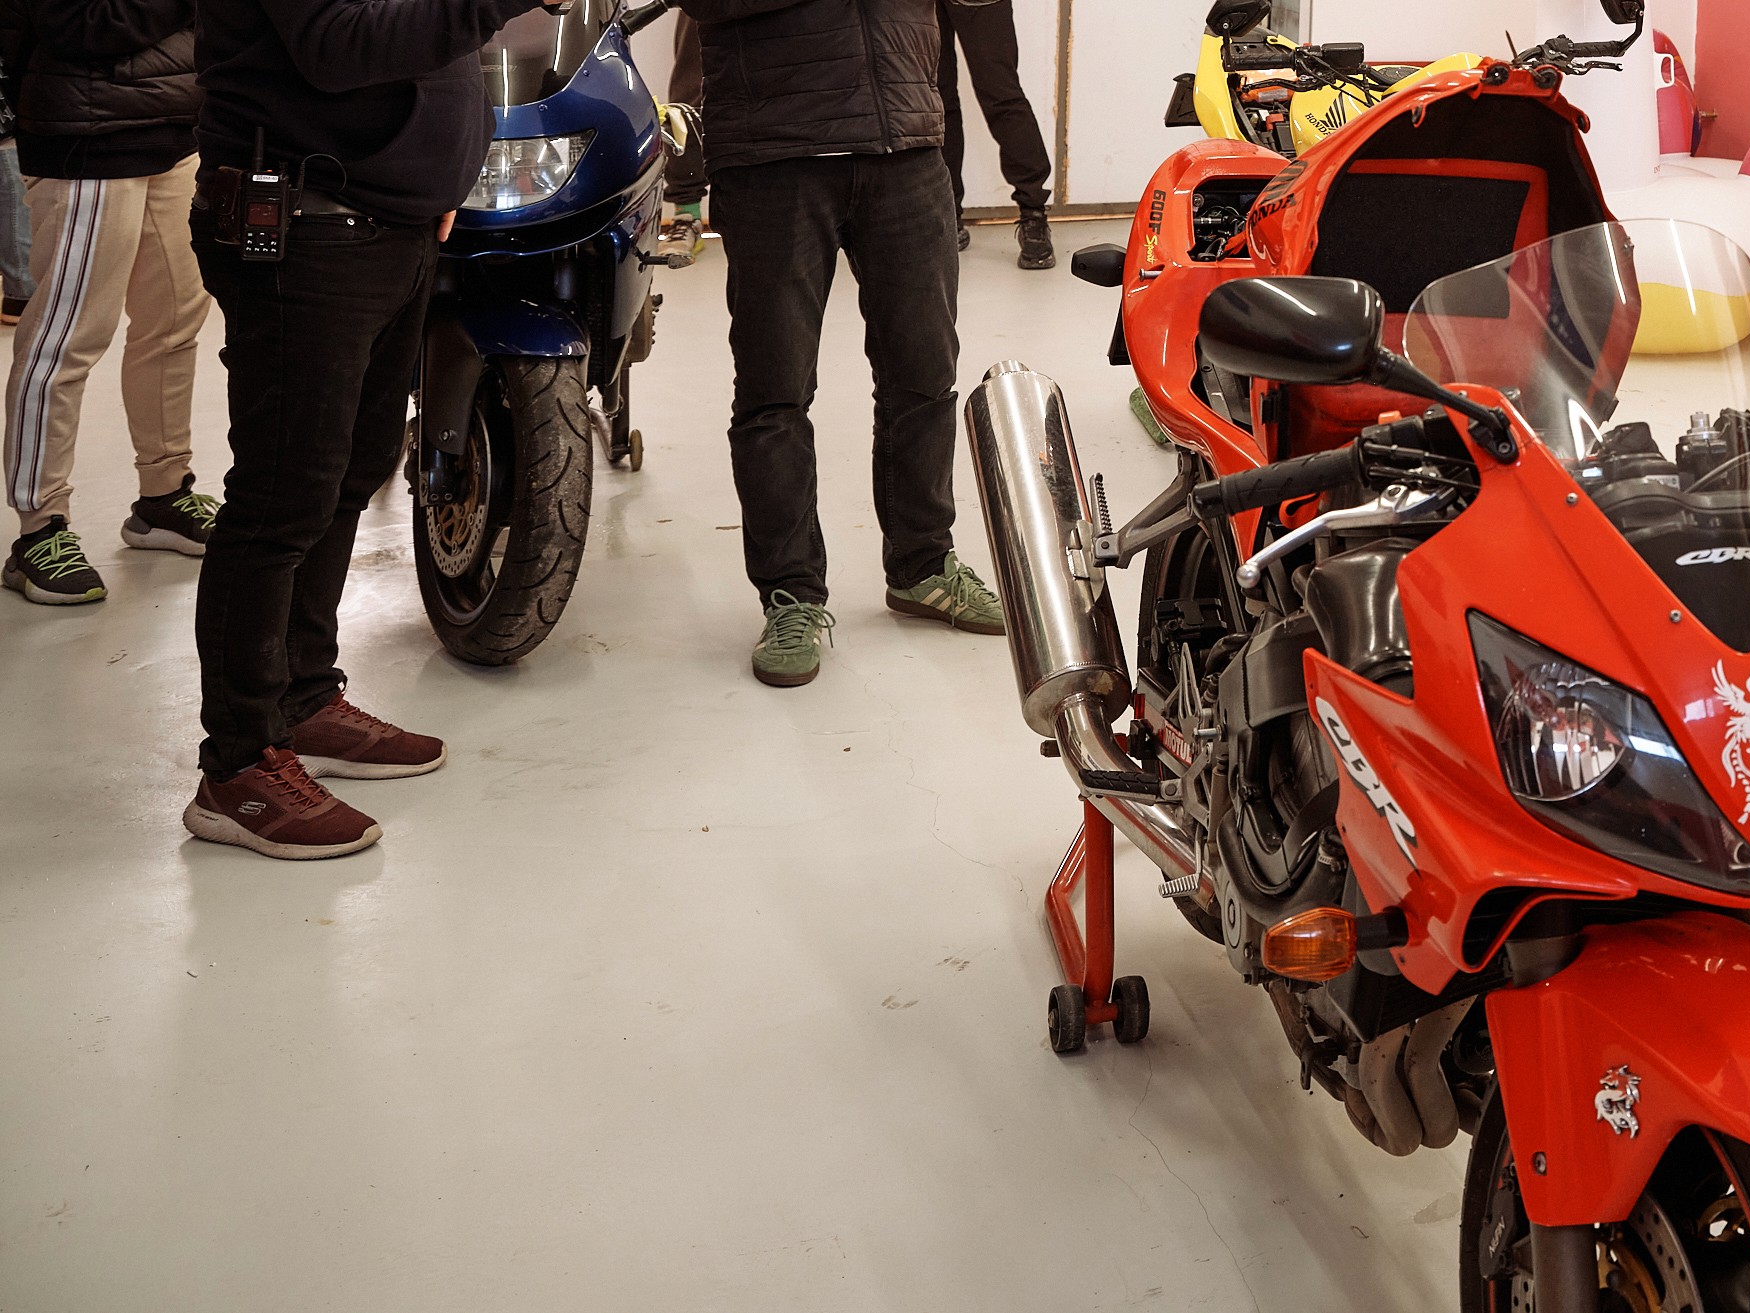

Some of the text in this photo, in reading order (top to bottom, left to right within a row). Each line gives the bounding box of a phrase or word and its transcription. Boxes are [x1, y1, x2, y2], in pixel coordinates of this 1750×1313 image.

[1142, 189, 1167, 265] 600F Sport
[1249, 192, 1298, 228] ONDA
[1164, 726, 1192, 765] MOTUL
[1315, 696, 1419, 876] CBR
